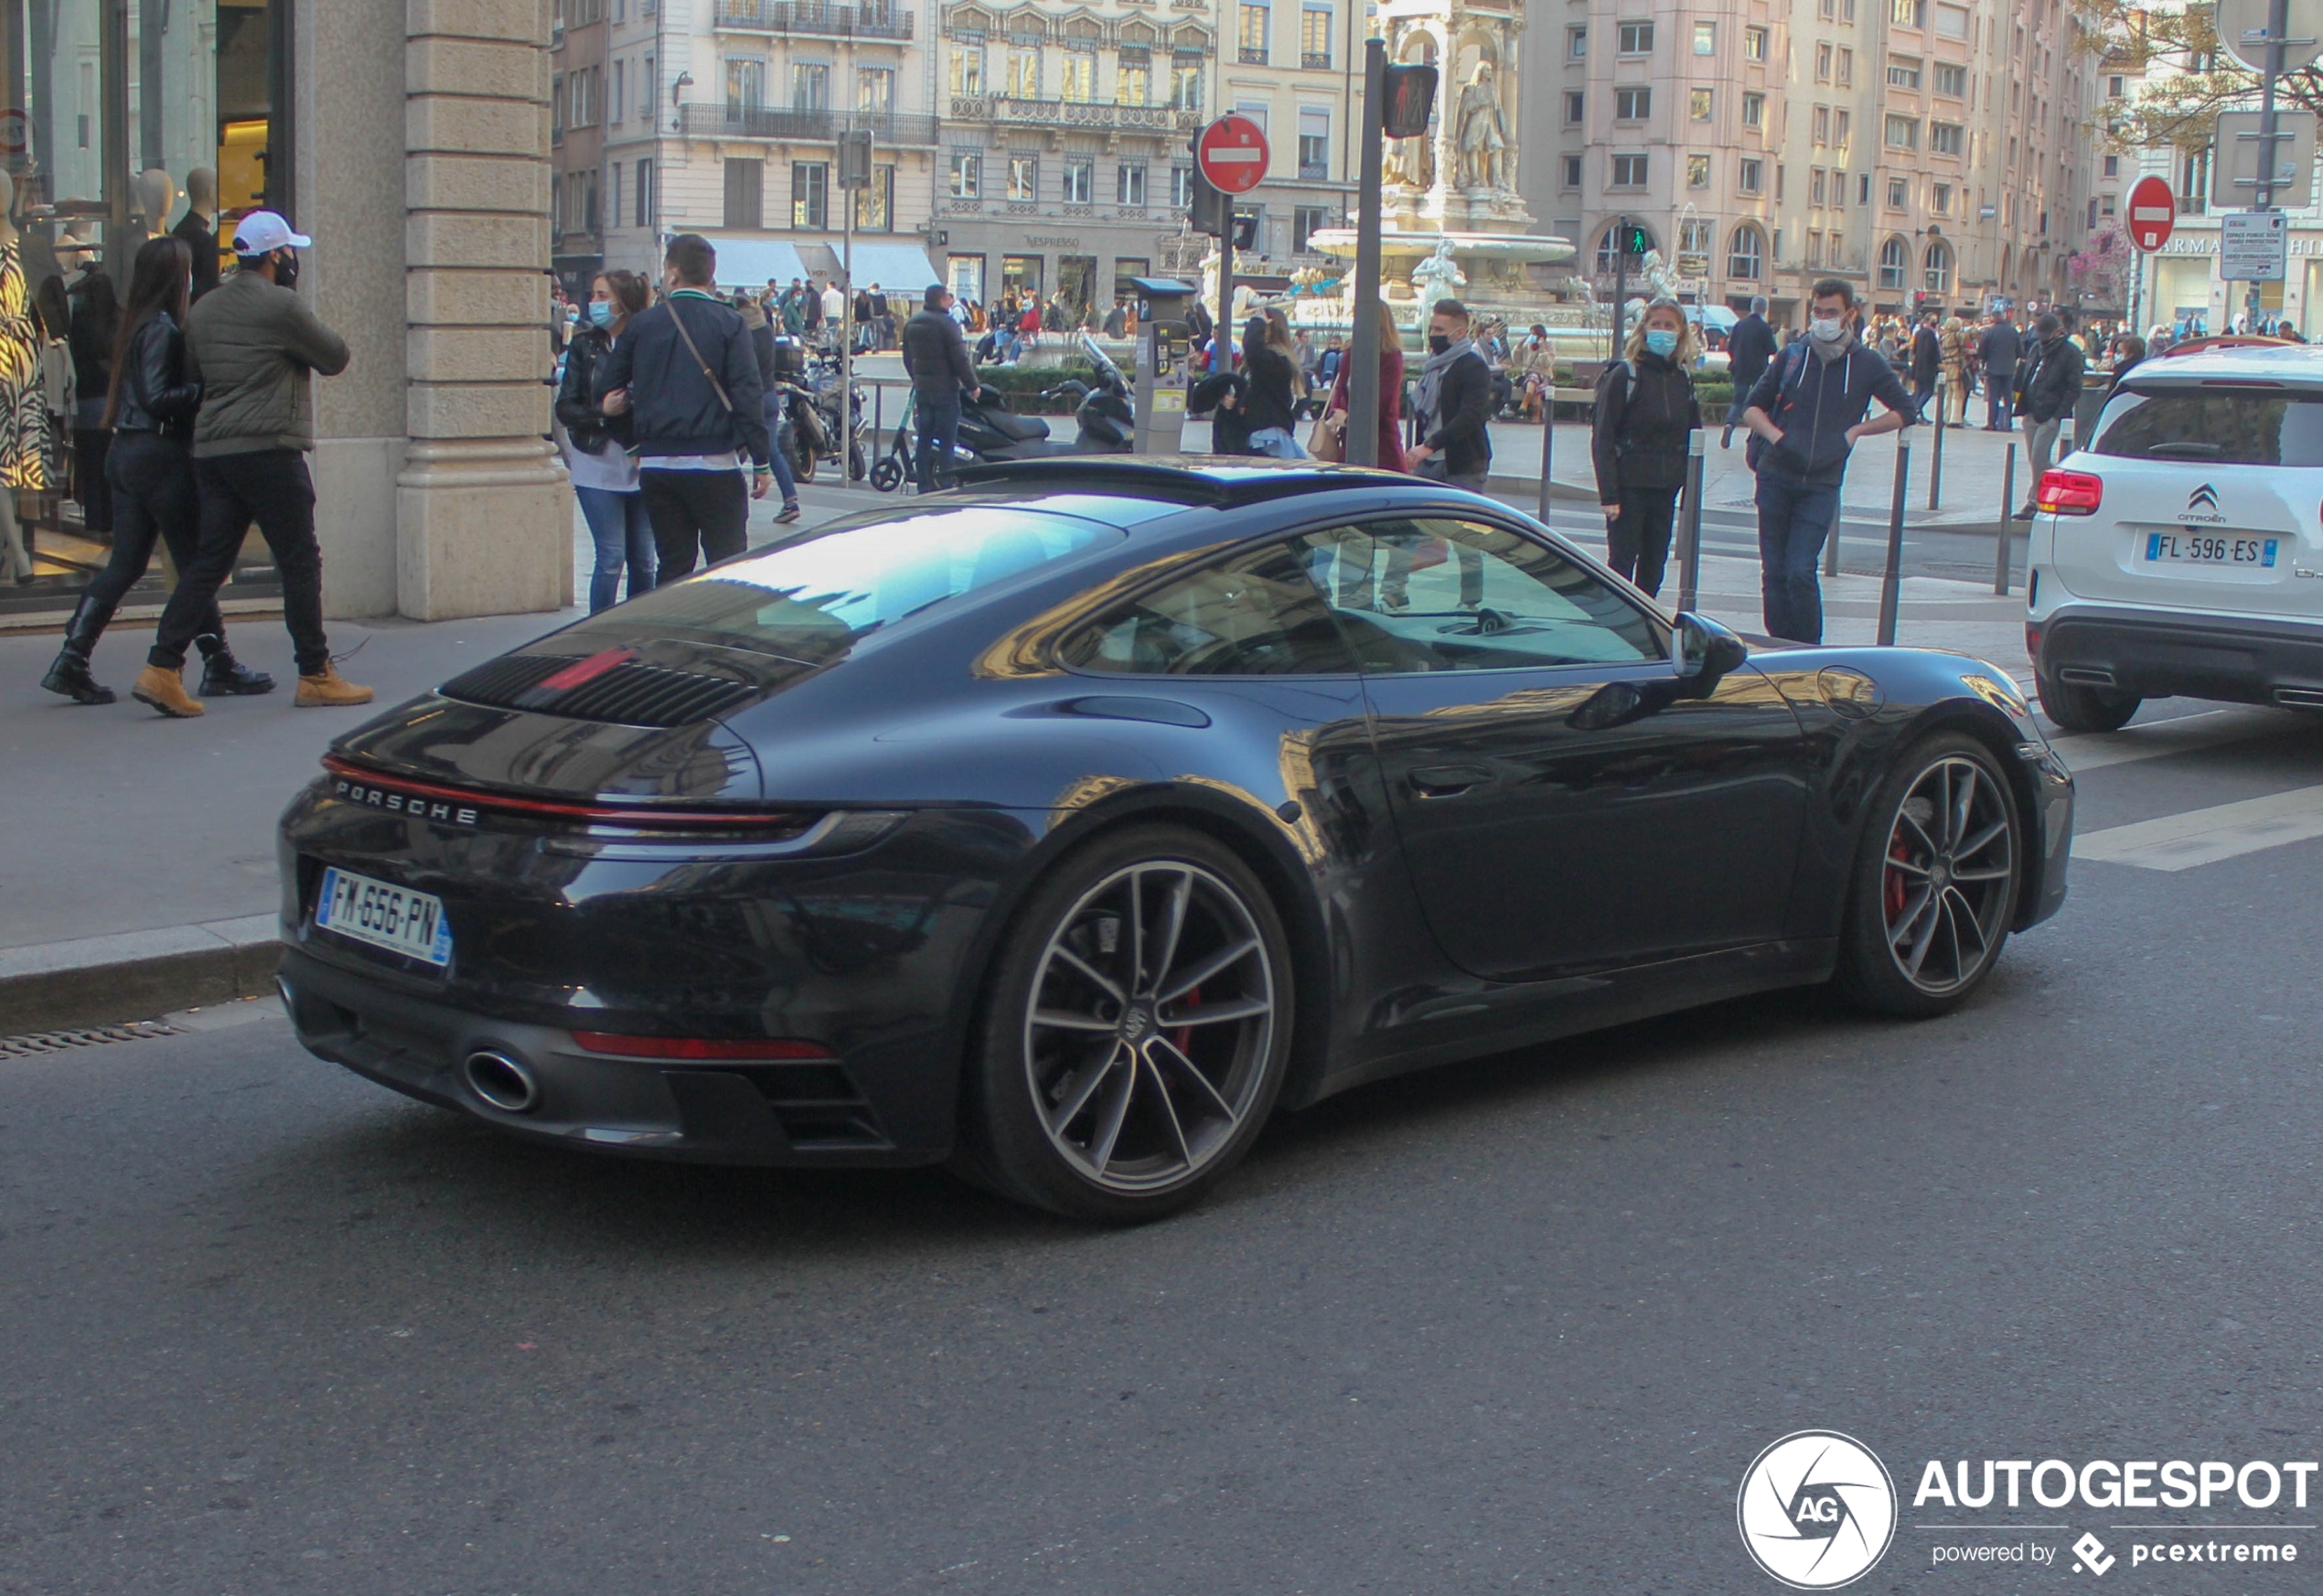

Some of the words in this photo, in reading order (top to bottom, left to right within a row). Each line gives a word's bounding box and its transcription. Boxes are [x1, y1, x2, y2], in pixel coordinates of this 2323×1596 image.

[1023, 234, 1079, 248] NESPRESSO
[2158, 536, 2259, 562] FL-596-ES
[2263, 554, 2274, 564] 69
[335, 781, 477, 824] PORSCHE
[331, 876, 439, 947] FM-656-PN
